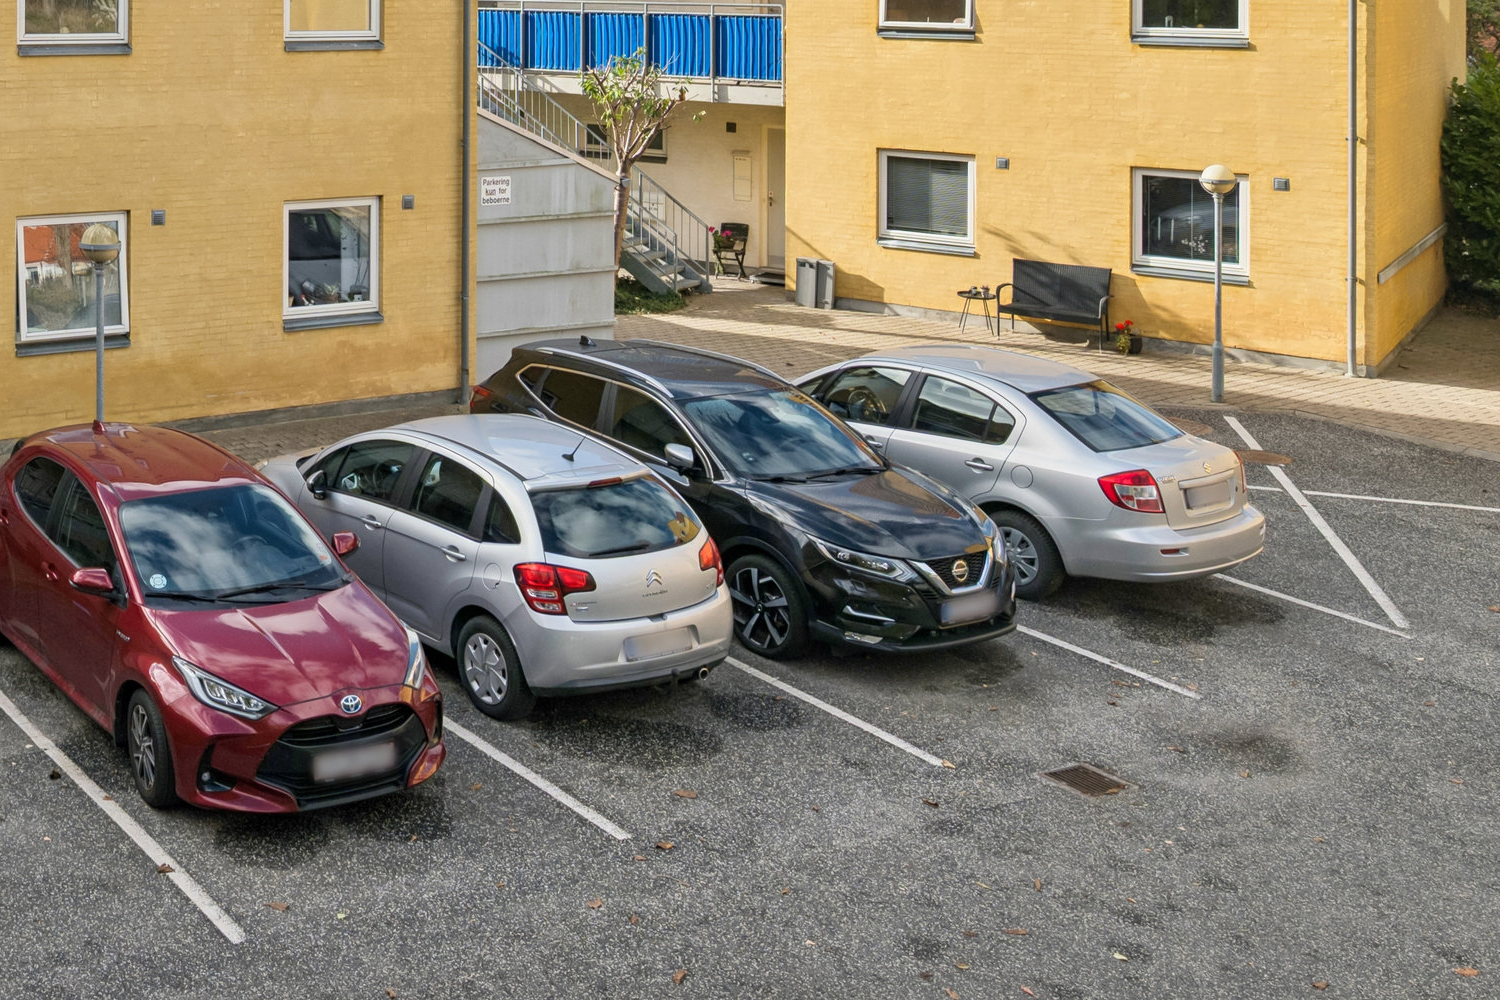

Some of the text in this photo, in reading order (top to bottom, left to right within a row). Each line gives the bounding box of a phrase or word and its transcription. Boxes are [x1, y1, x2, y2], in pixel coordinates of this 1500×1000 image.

[482, 178, 510, 187] Parkering
[485, 187, 507, 196] kun for
[482, 196, 510, 205] beboerne
